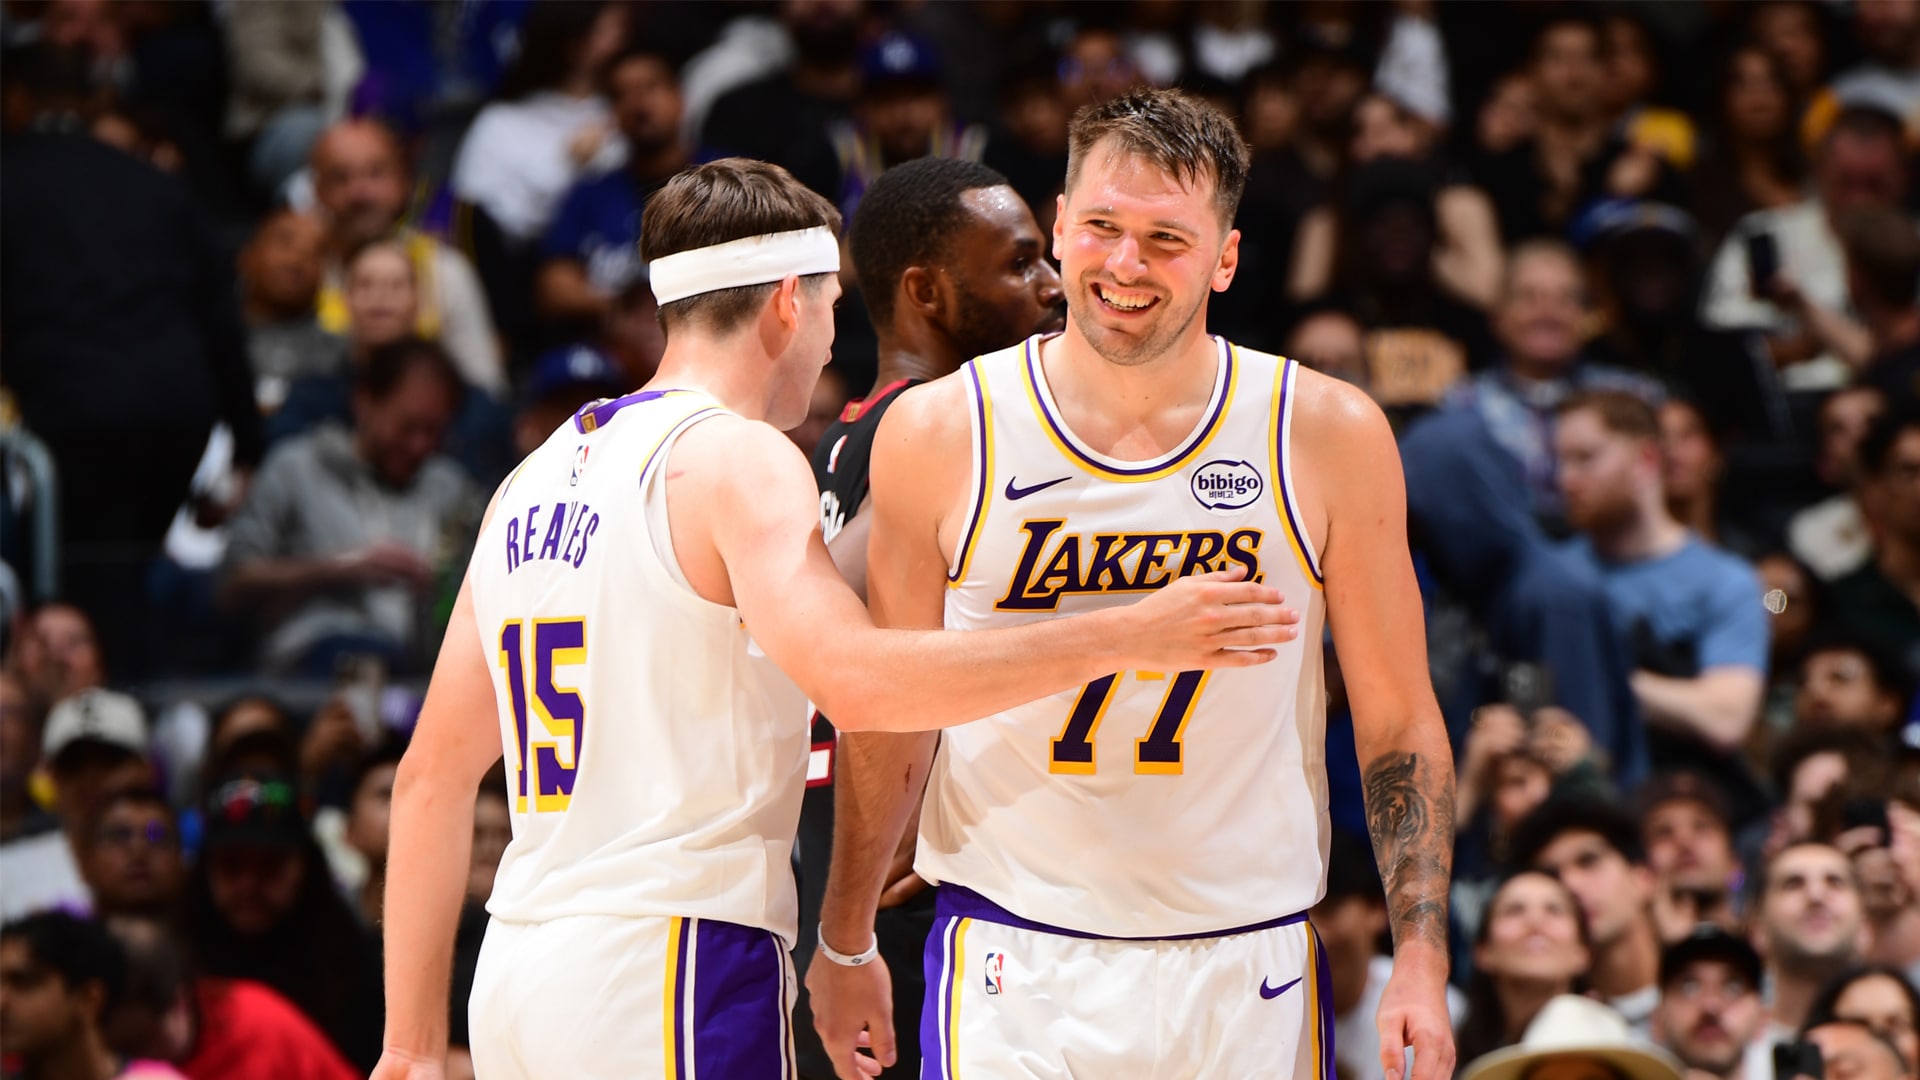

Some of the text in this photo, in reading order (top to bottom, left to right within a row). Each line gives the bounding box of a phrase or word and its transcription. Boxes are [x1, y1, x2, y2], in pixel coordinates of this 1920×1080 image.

[1198, 473, 1258, 495] bibigo
[1209, 491, 1234, 499] 비비고
[992, 518, 1265, 612] LAKERS
[498, 615, 587, 813] 15
[1048, 670, 1213, 775] 77
